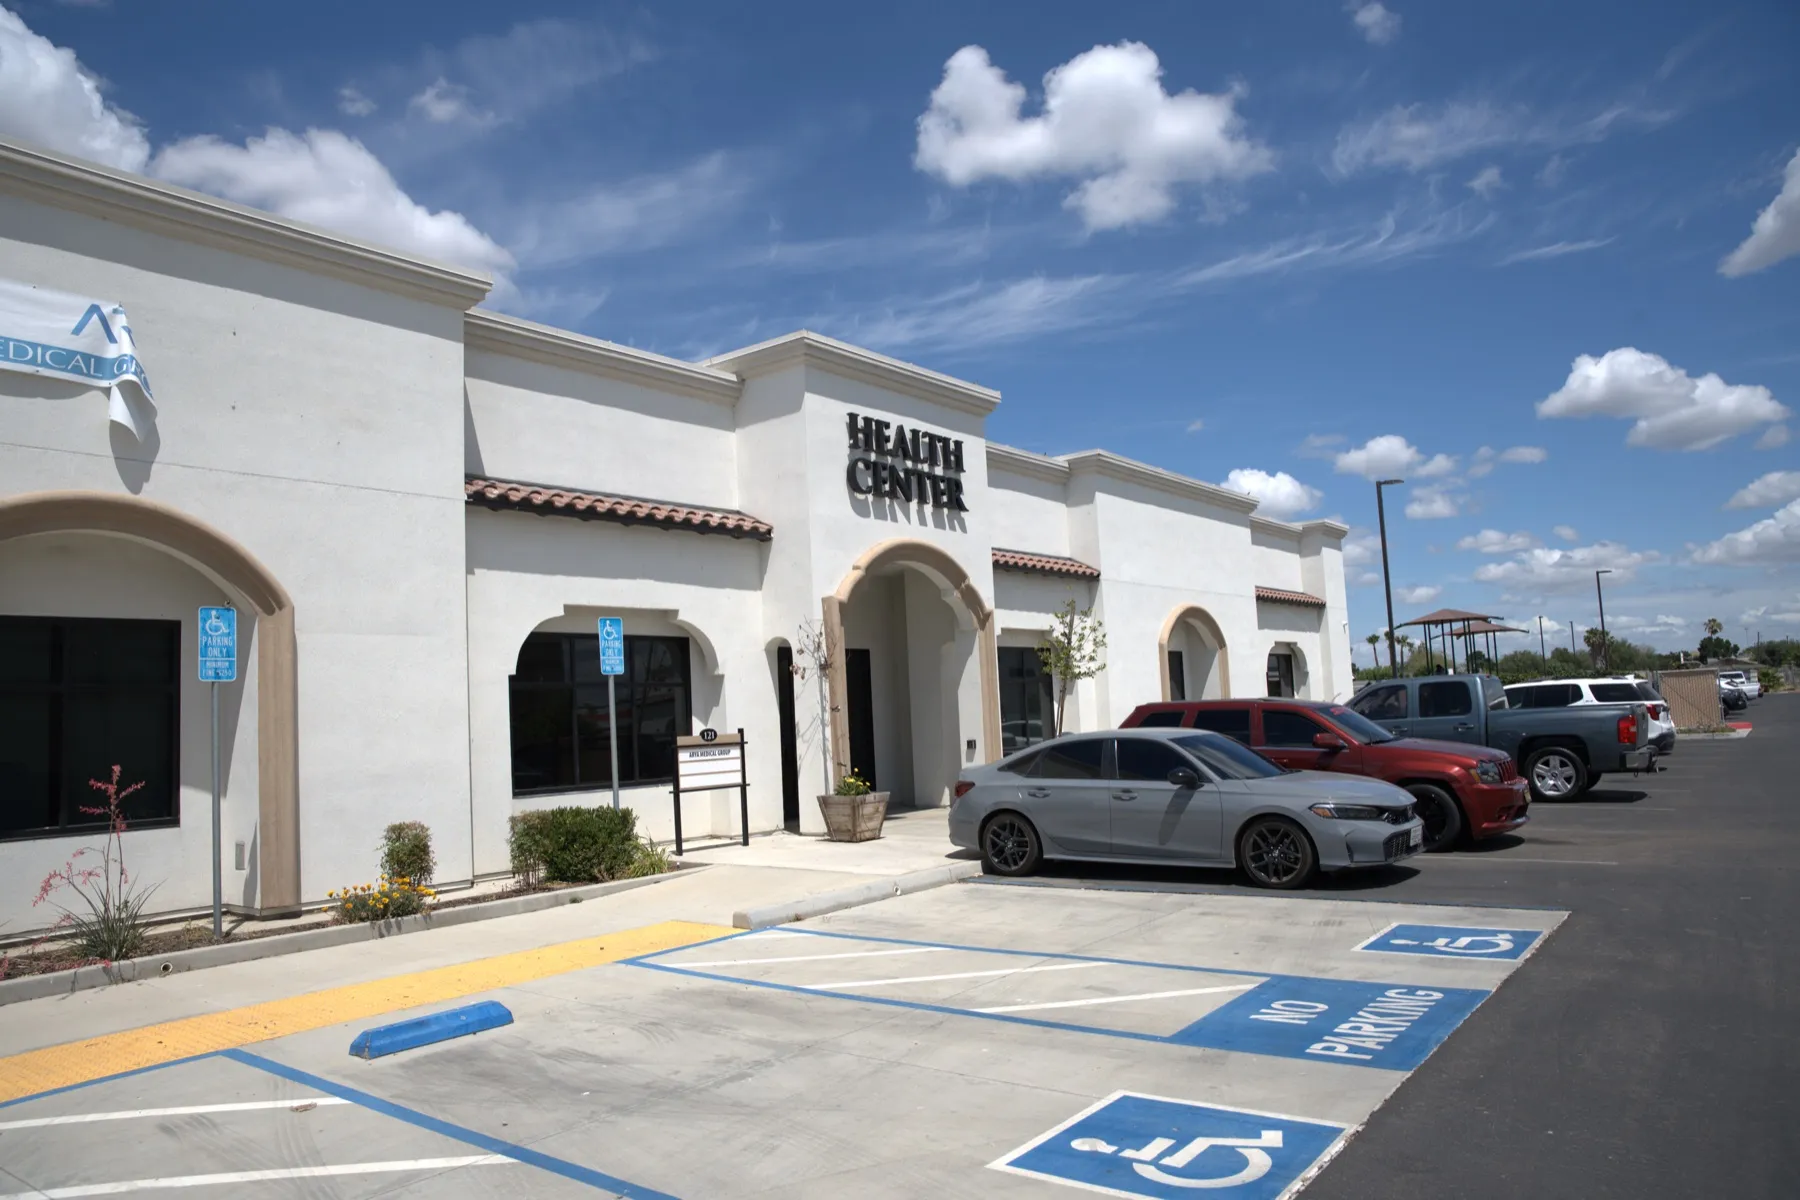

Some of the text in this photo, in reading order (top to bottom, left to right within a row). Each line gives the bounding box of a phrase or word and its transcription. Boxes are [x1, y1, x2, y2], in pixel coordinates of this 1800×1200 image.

[846, 412, 966, 472] HEALTH
[846, 458, 969, 512] CENTER
[202, 635, 233, 647] PARKING
[208, 647, 227, 657] ONLY
[704, 731, 715, 740] 121
[700, 750, 717, 758] MEDICAL
[717, 749, 731, 757] GROUP
[1249, 1000, 1329, 1025] NO
[1305, 988, 1444, 1060] PARKING
